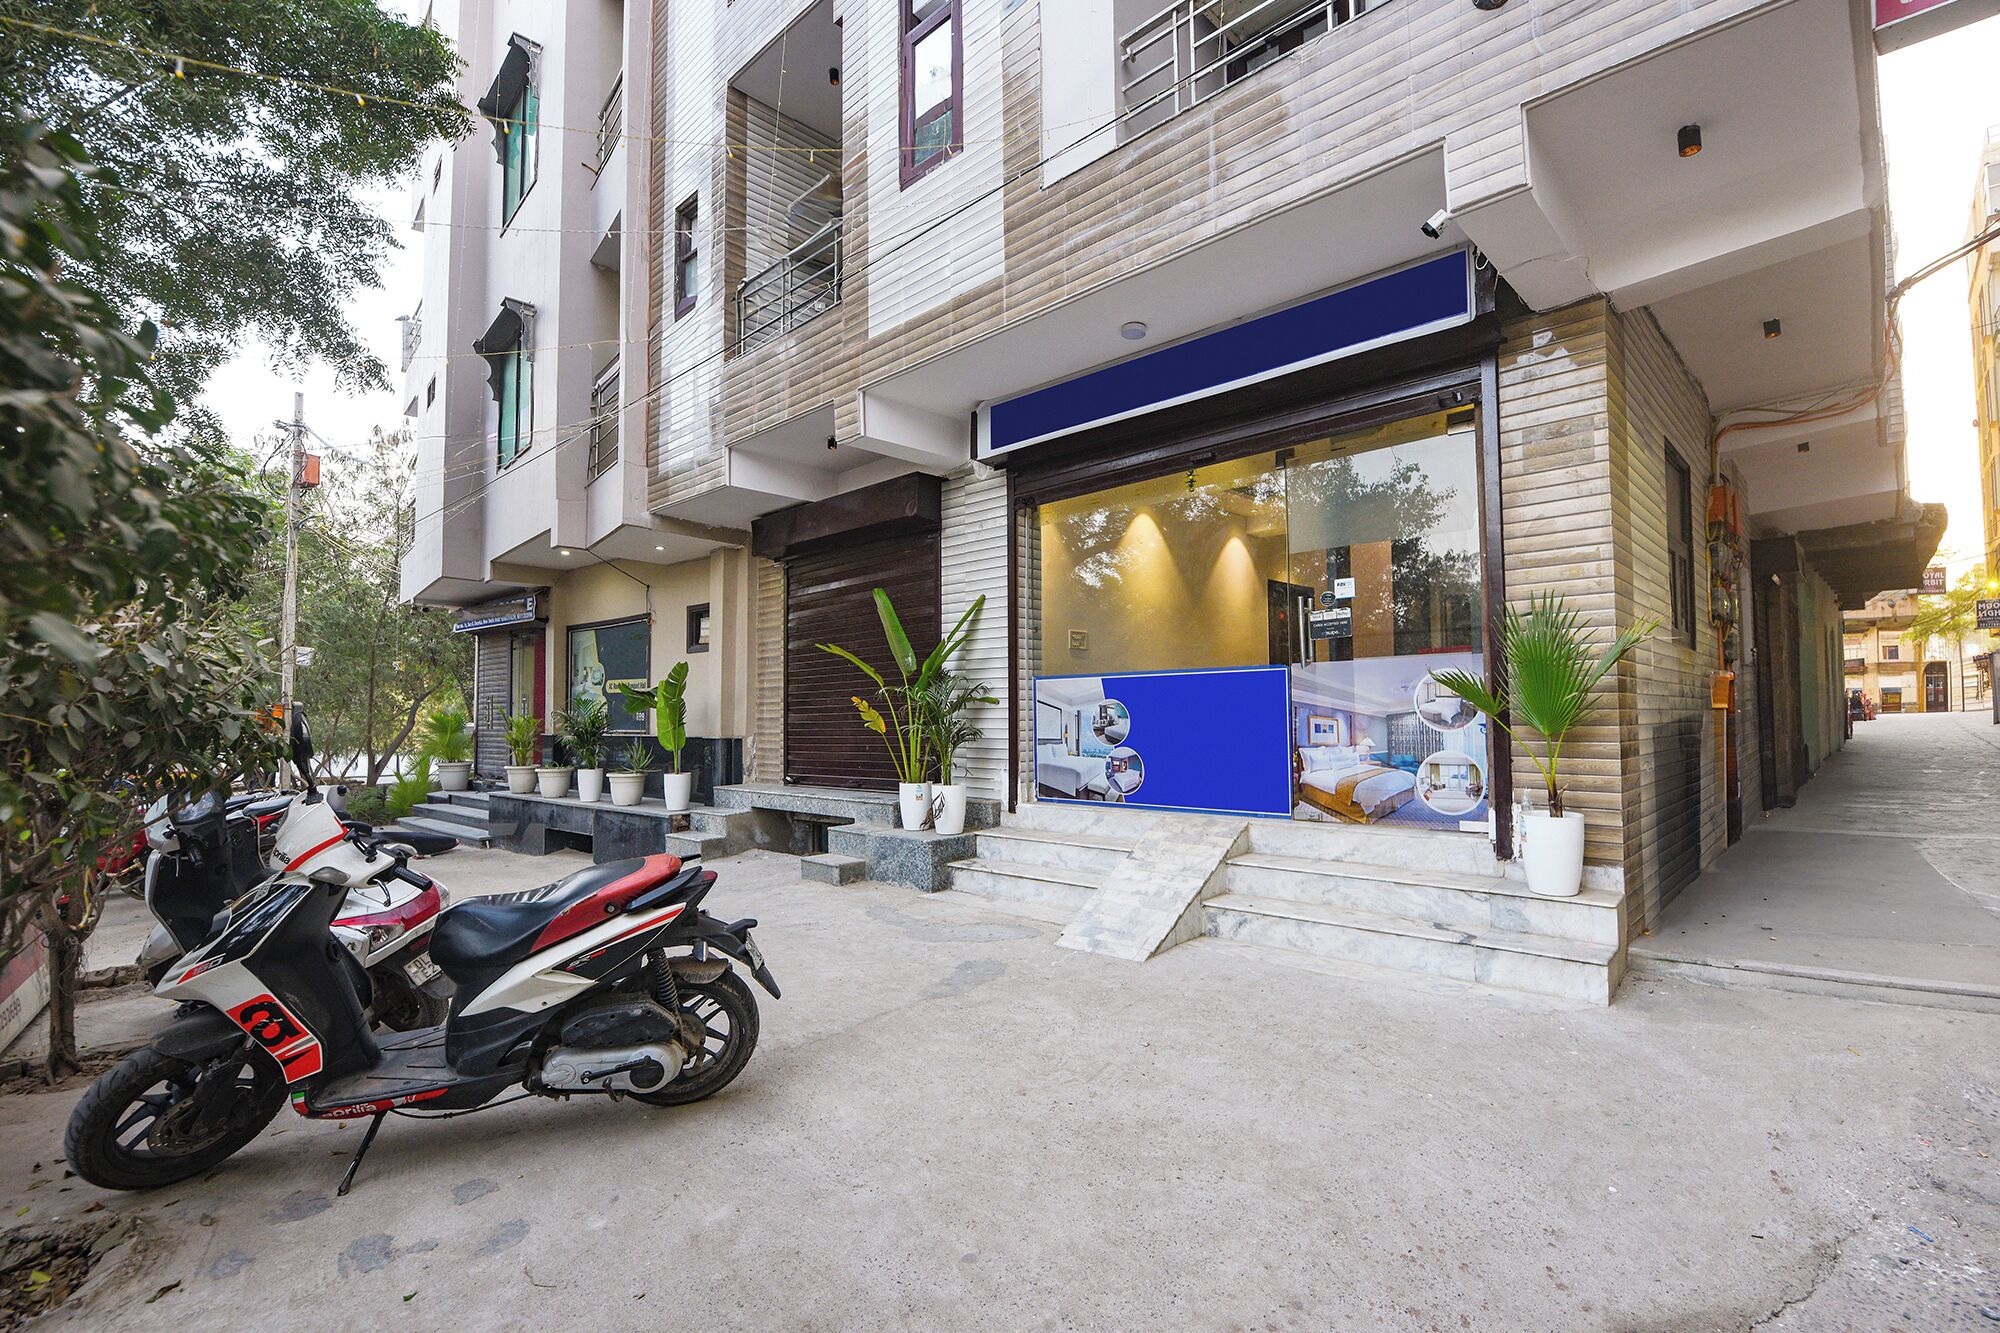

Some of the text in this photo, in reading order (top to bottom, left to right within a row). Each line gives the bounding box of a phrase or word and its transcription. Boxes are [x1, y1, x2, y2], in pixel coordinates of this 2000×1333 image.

[1922, 571, 1945, 579] OYAL
[1978, 602, 2000, 610] MOO
[1977, 609, 2000, 618] LIGH
[273, 847, 291, 865] prilia
